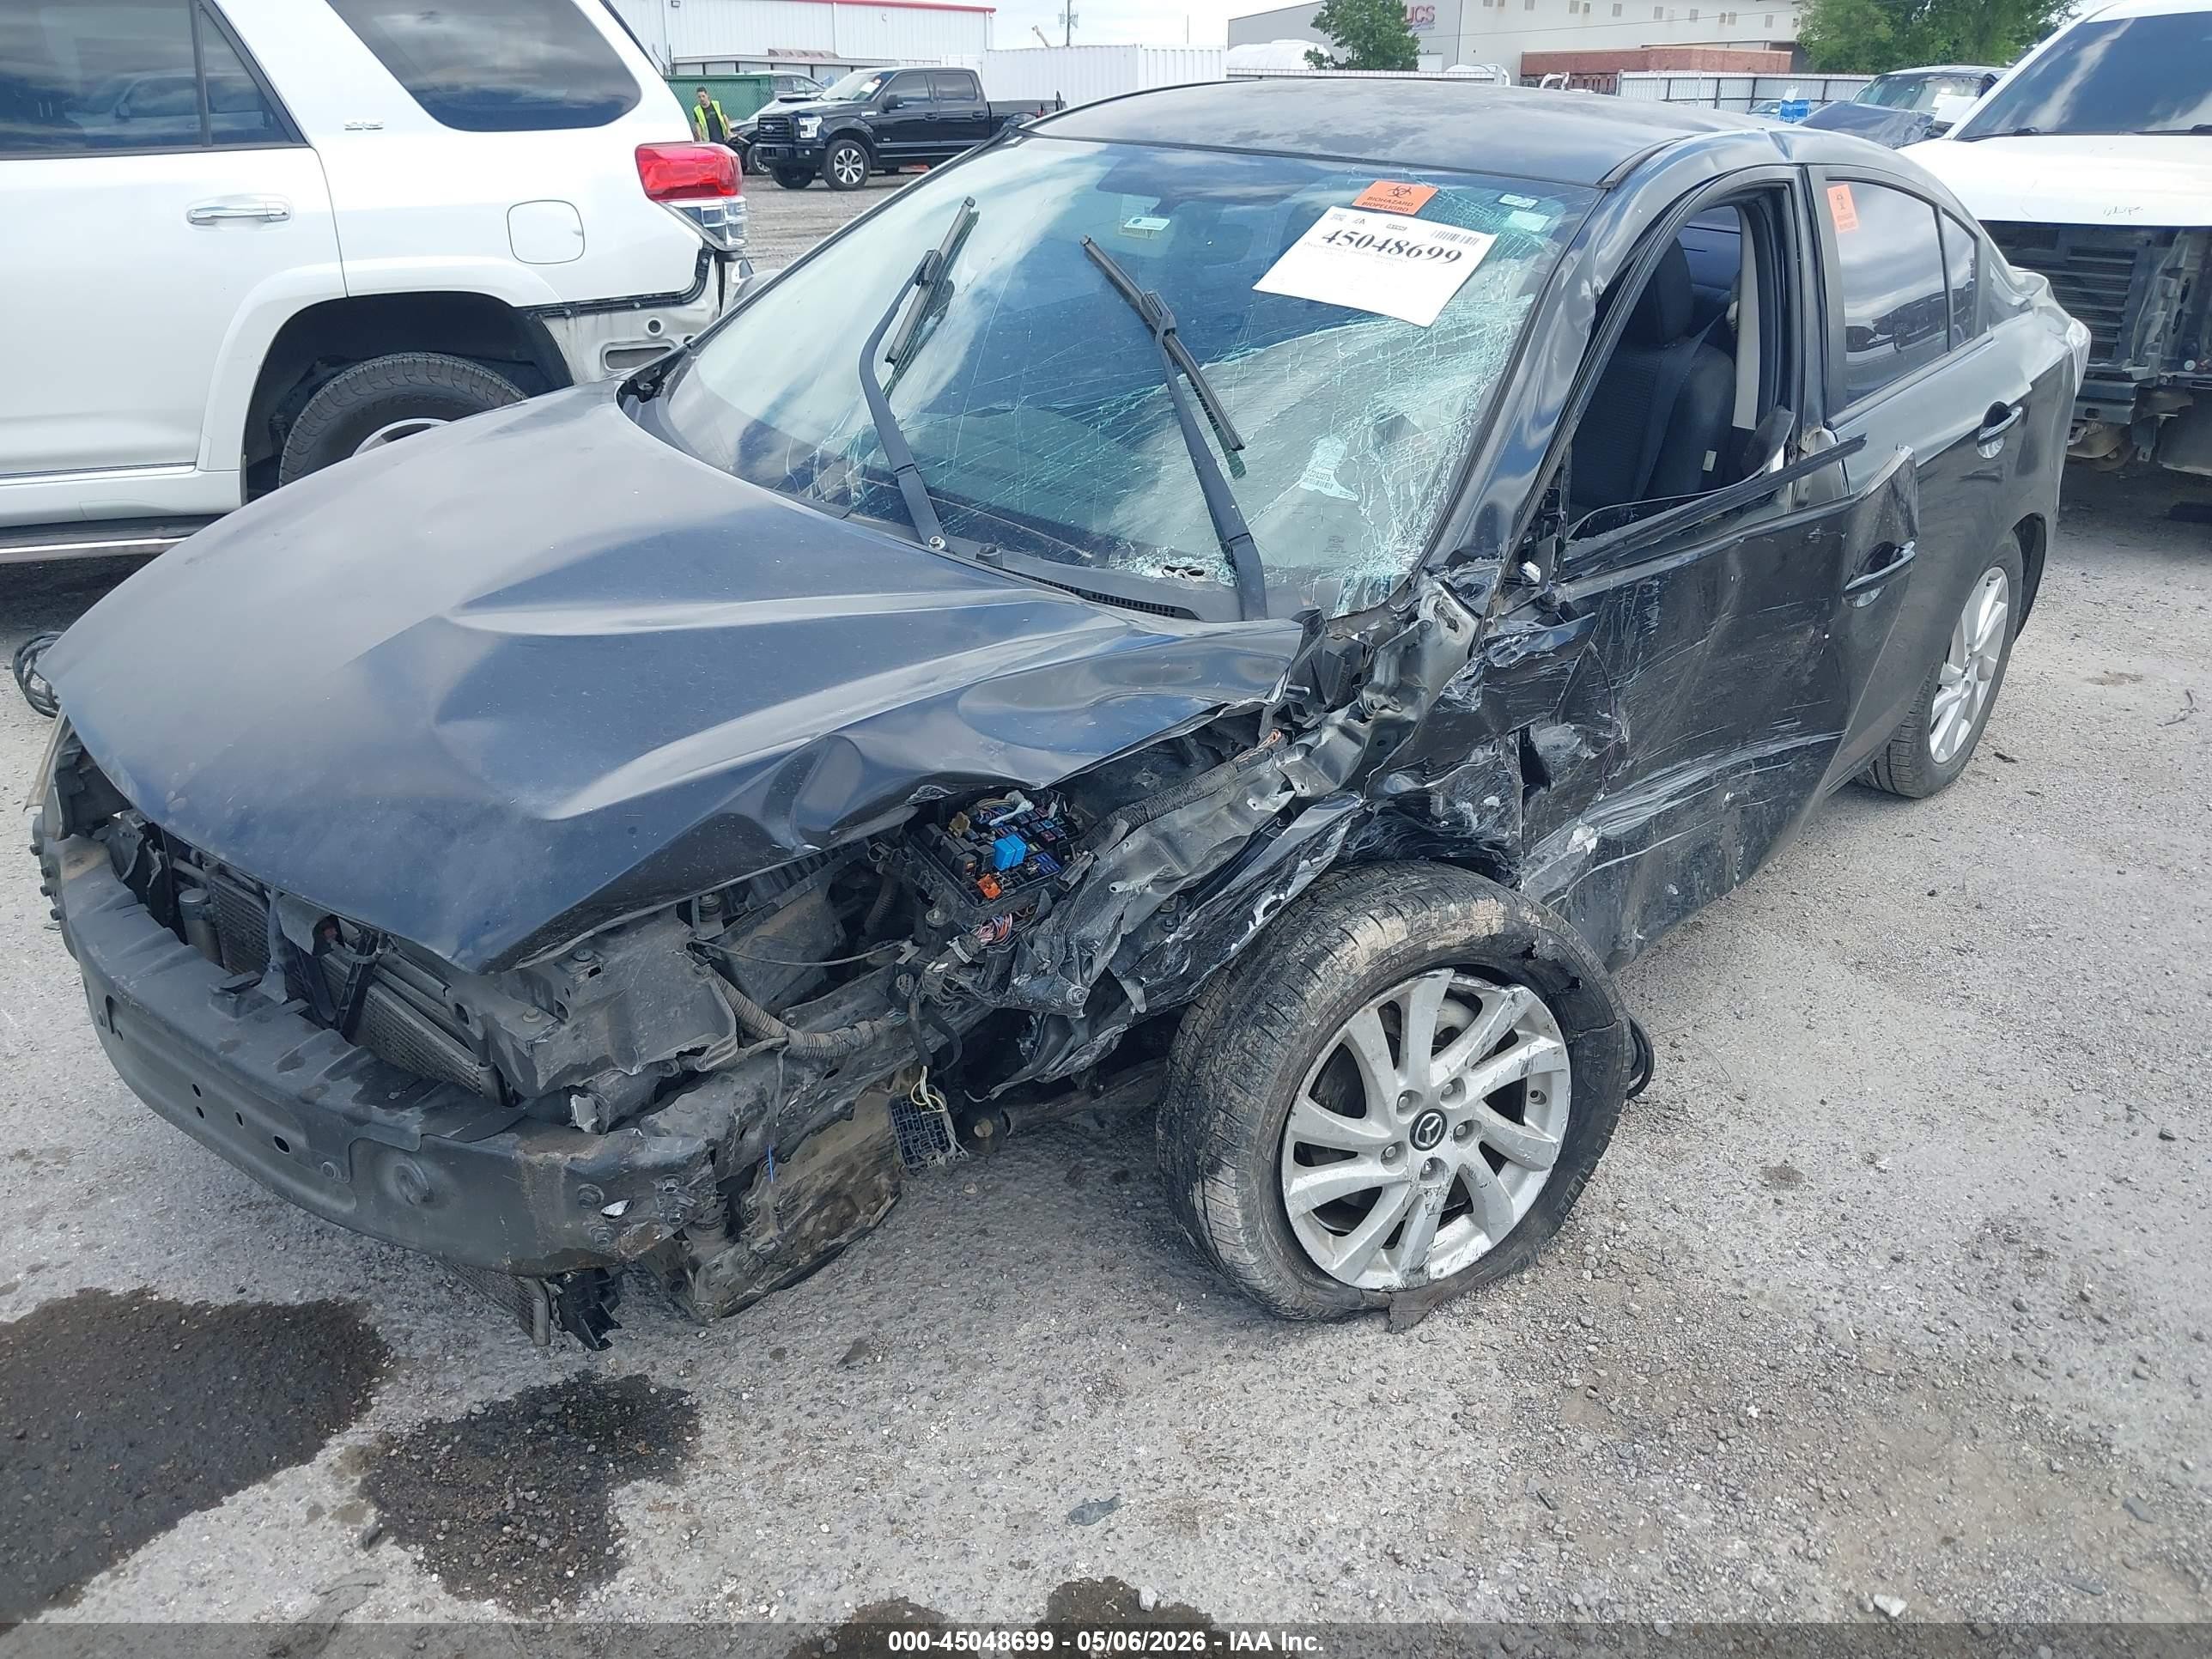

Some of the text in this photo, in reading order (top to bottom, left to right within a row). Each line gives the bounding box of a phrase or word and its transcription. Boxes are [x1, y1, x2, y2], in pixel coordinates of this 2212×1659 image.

[1367, 197, 1413, 206] BIOHAZARD
[1362, 202, 1409, 212] BIOPELIGRO
[1321, 228, 1462, 264] 45048699
